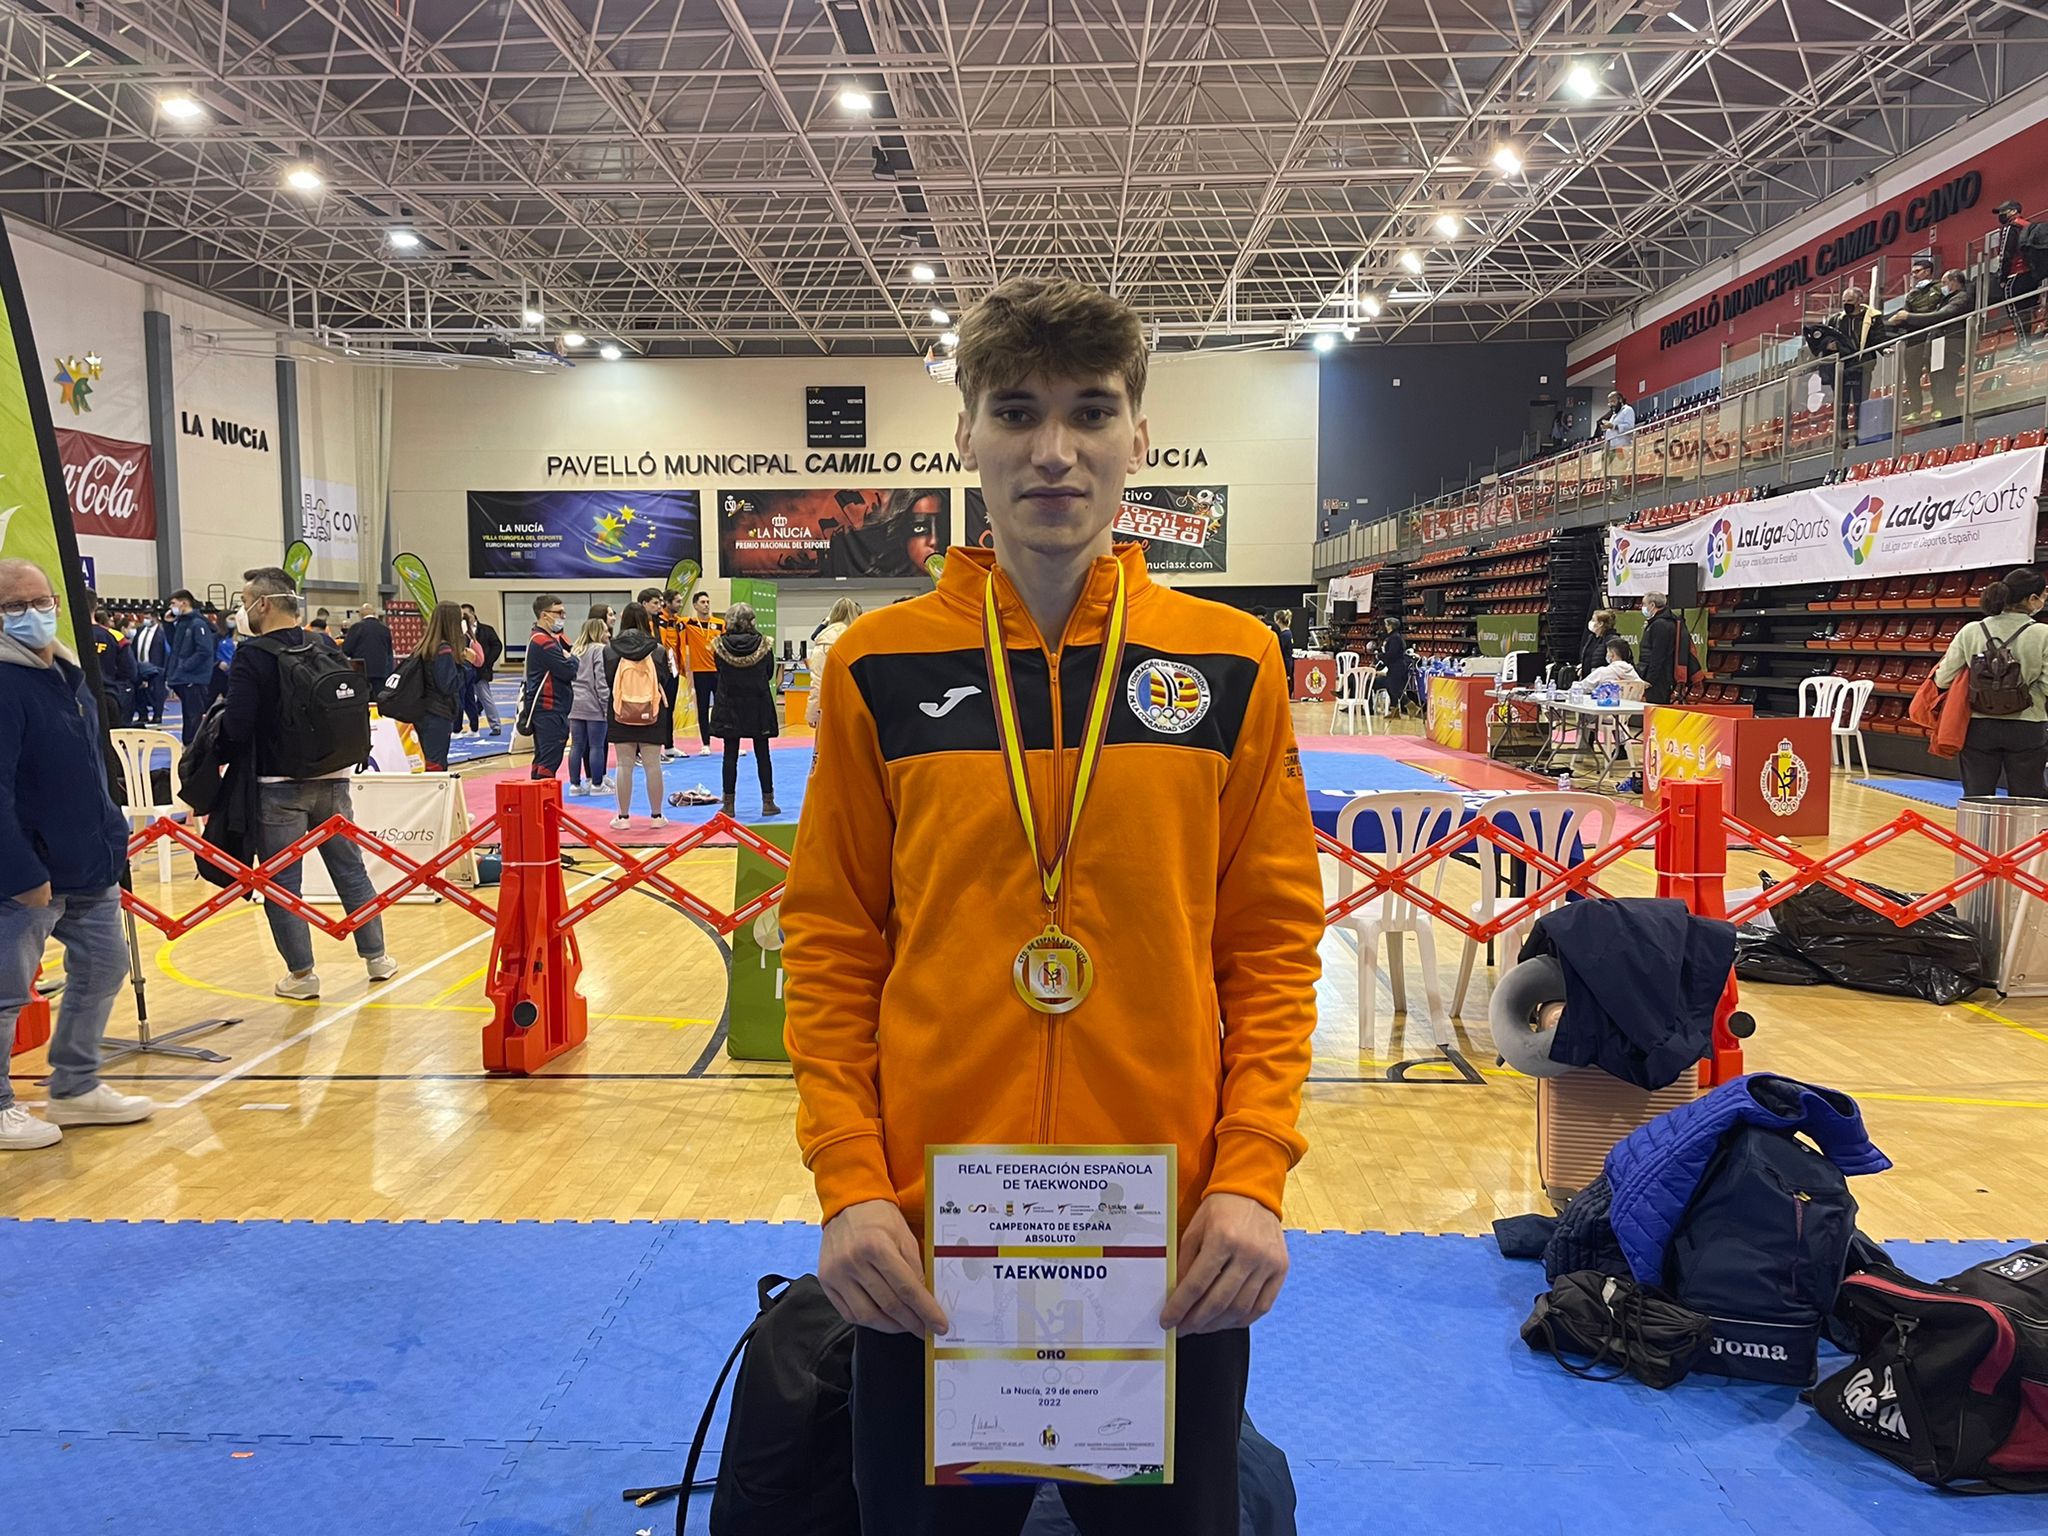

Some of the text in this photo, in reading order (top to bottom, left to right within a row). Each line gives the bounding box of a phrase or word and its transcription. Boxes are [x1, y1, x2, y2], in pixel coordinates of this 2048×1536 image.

[1723, 255, 1813, 321] MUNICIPAL
[1815, 210, 1899, 275] CAMILO
[1905, 170, 1982, 233] CANO
[182, 411, 204, 437] LA
[547, 451, 962, 476] PAVELLÓ MUNICIPAL CAMILO CAN
[1146, 447, 1209, 468] UCíA
[63, 454, 140, 519] a-Cola
[1124, 490, 1152, 501] tivo
[1885, 482, 2028, 531] LaLiga4Sports
[499, 521, 544, 533] LA NUCÍA
[1119, 511, 1181, 531] ABRIL
[1184, 517, 1200, 525] de
[757, 528, 770, 538] LA
[1117, 519, 1198, 543] 2020
[735, 540, 831, 549] PREMIO NACIONAL DEL DEPORTE
[1146, 560, 1213, 569] nuciasx.com
[1062, 937, 1088, 965] ABSOLUTO
[958, 1161, 1153, 1175] REAL FEDERACIÓN ESPAÑOLA
[1003, 1179, 1108, 1190] DE TAEKWONDO
[989, 1220, 1112, 1231] CAMPEONATO DE ESPAÑA
[1025, 1234, 1076, 1243] ABSOLUTO
[993, 1265, 1107, 1280] TAEKWONDO
[1036, 1349, 1066, 1360] ORO
[1709, 1337, 1789, 1361] Joma
[1000, 1386, 1099, 1397] La Nucía, 29 de enero
[1038, 1399, 1061, 1407] 2022
